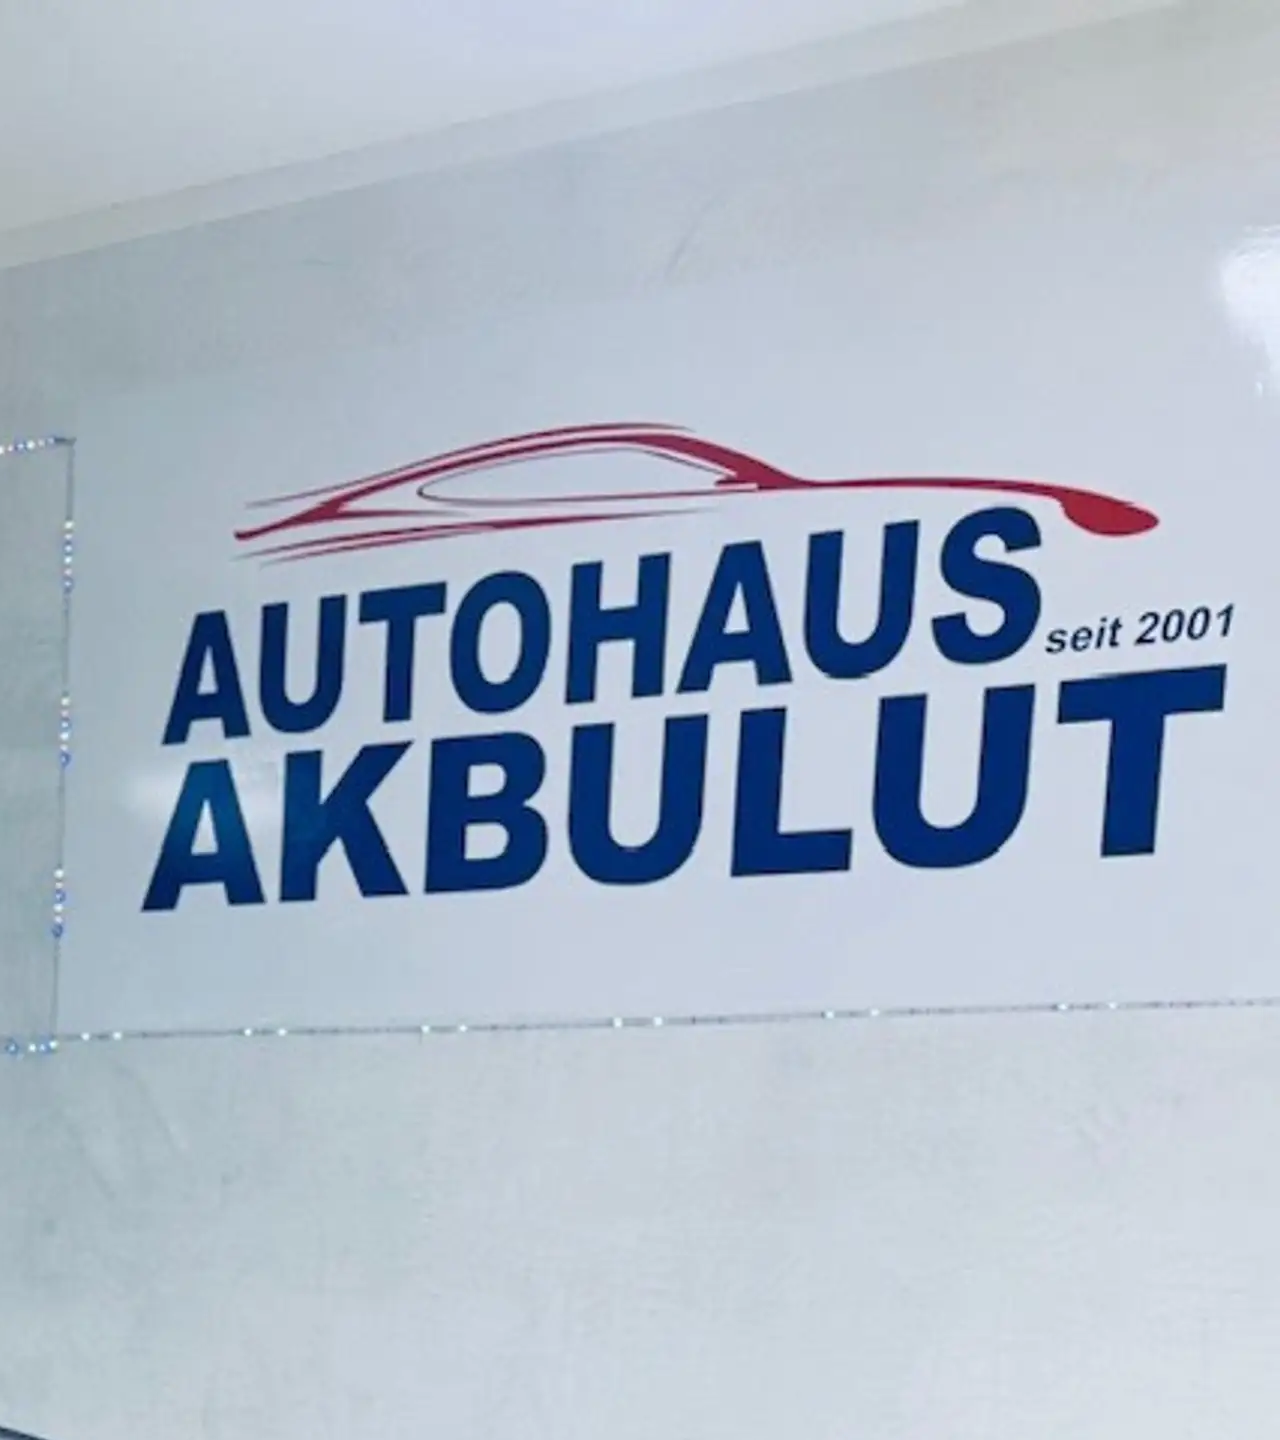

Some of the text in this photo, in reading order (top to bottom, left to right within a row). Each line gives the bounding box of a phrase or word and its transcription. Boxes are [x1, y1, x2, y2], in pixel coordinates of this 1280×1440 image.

[162, 506, 1042, 745] AUTOHAUS
[1045, 603, 1234, 655] seit 2001
[141, 664, 1228, 912] AKBULUT
